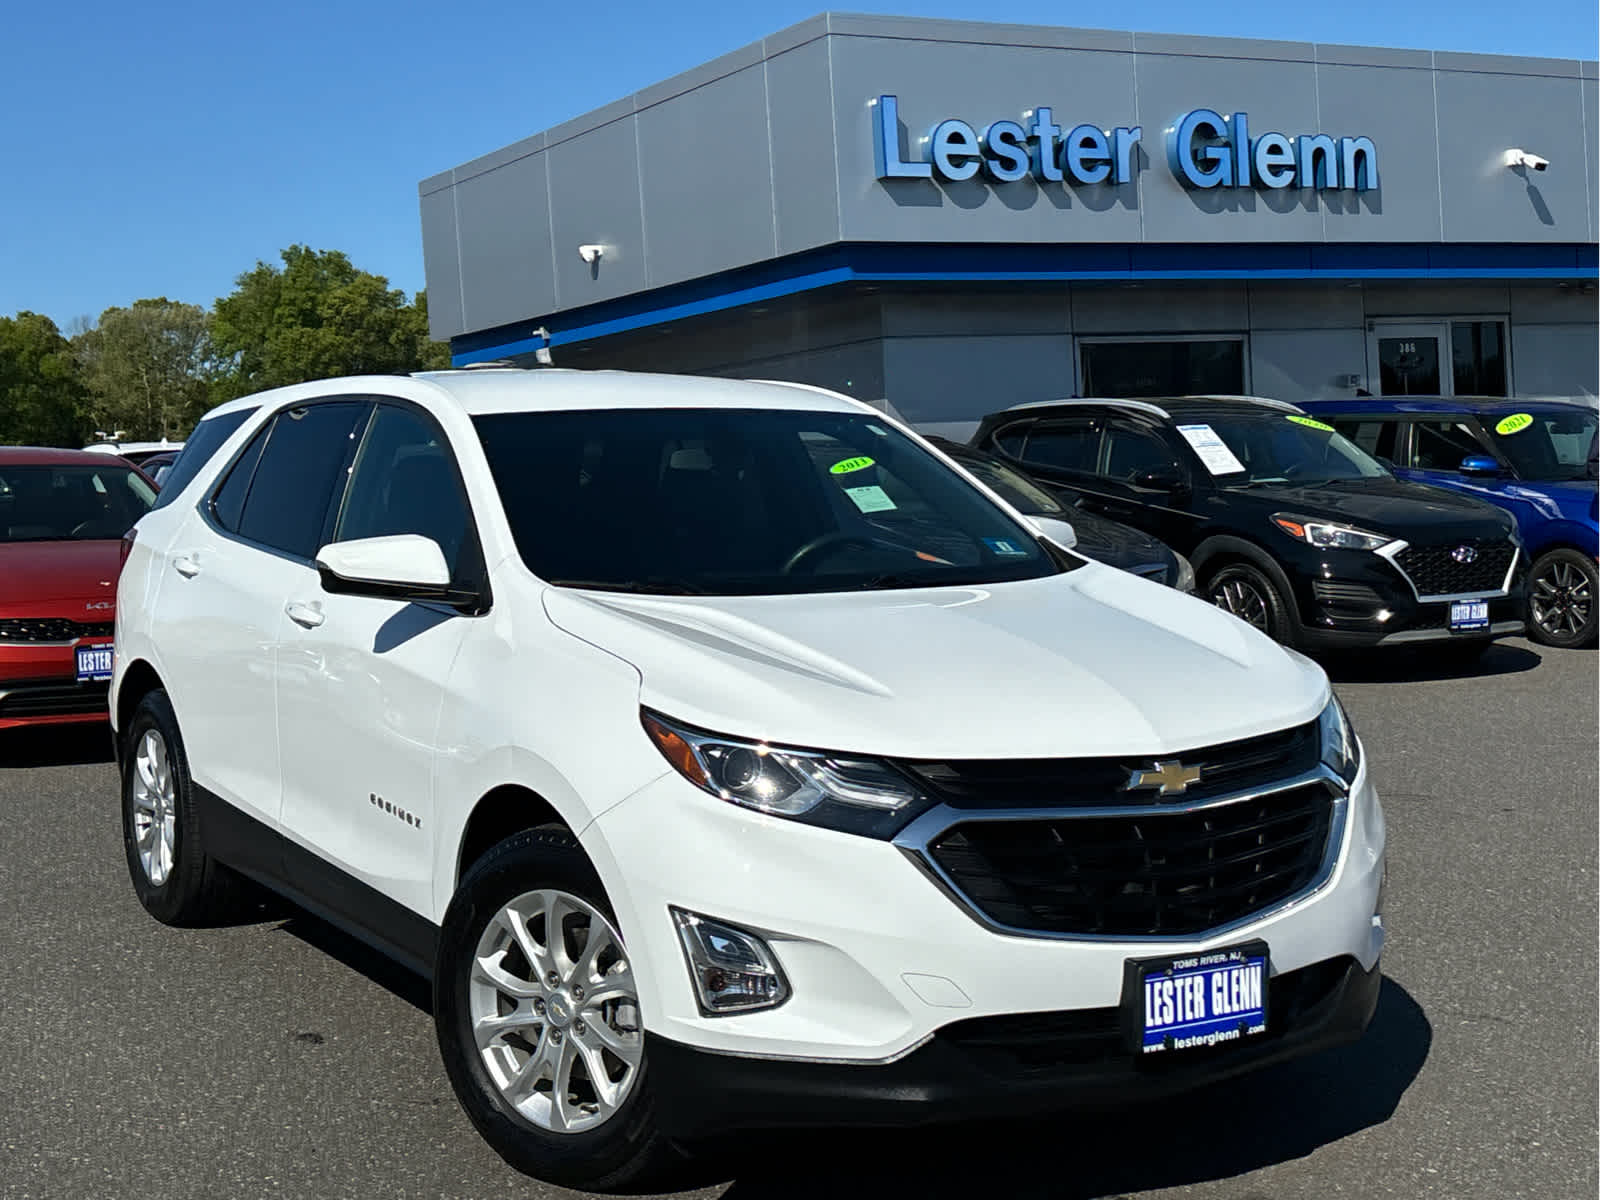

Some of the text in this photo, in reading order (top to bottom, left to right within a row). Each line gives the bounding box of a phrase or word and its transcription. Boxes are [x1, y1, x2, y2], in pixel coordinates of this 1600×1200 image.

[873, 94, 1379, 191] Lester Glenn
[1503, 415, 1527, 432] 2021
[78, 652, 111, 671] LESTER
[370, 793, 421, 829] EQUINOX
[1173, 958, 1198, 970] TOMS
[1145, 966, 1262, 1027] LESTER GLENN
[1174, 1029, 1240, 1049] lesterglenn
